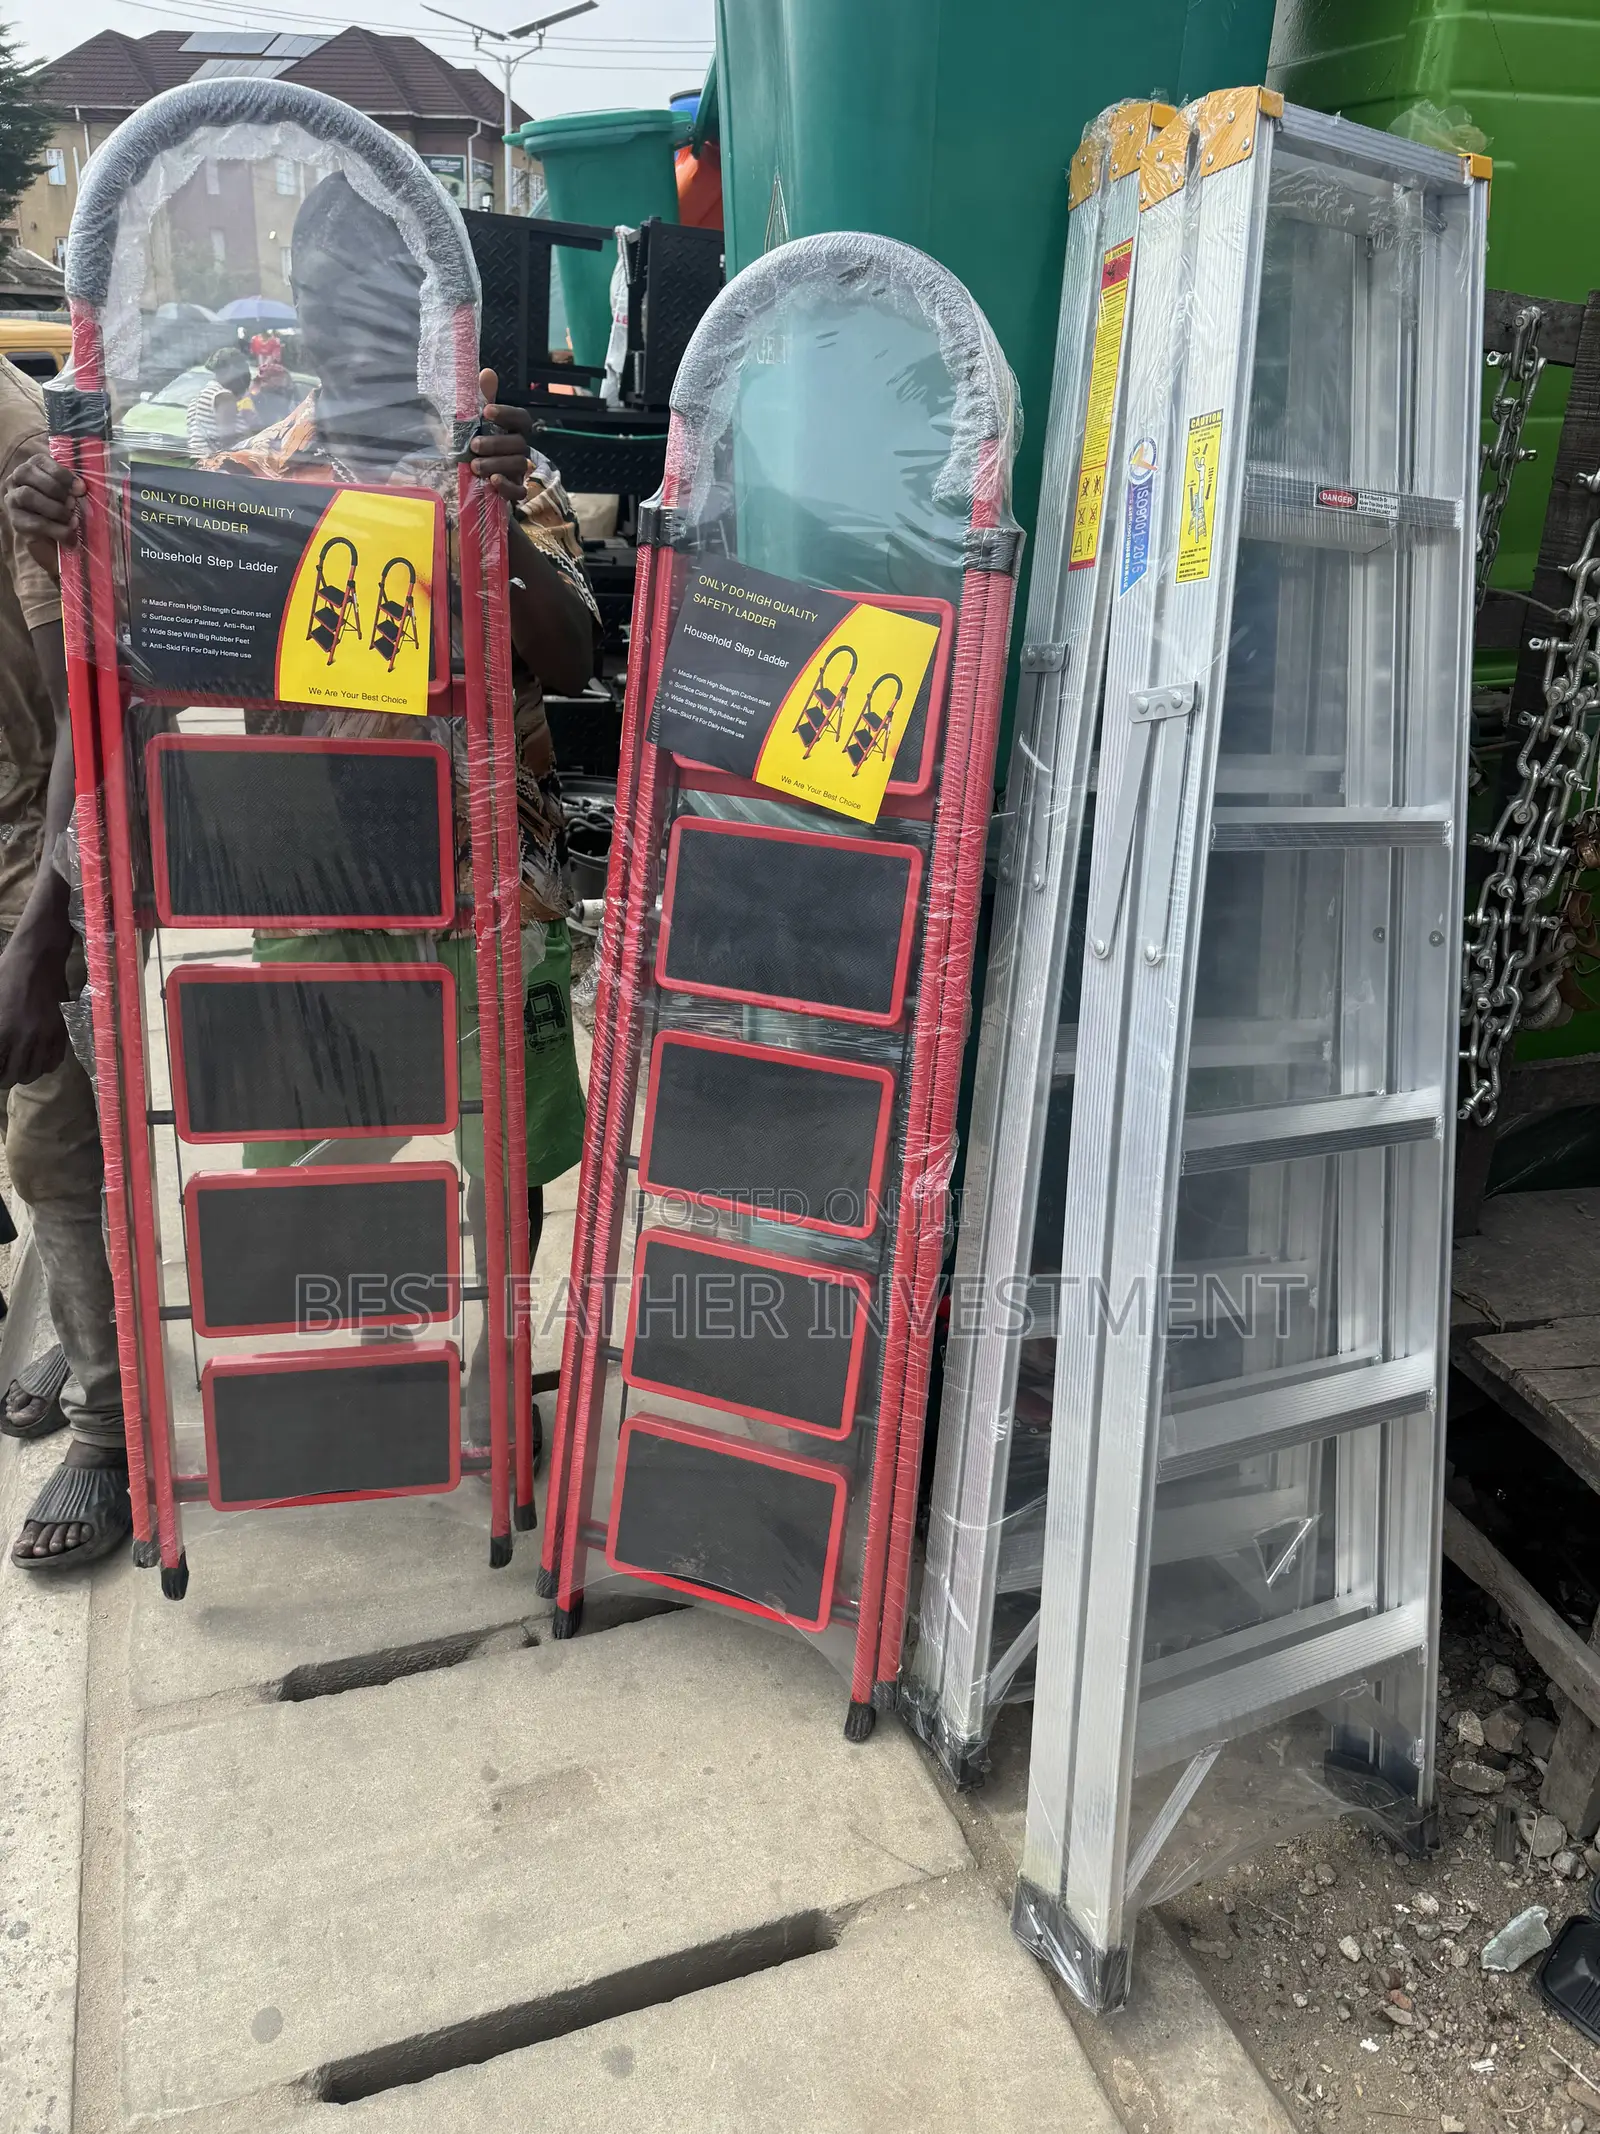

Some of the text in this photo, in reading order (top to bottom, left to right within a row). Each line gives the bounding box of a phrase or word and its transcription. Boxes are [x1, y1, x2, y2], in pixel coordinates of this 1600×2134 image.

[1191, 412, 1222, 428] CAUTION
[141, 490, 294, 519] ONLY DO HIGH QUALITY
[1322, 493, 1353, 504] DANGER
[141, 511, 248, 534] SAFETY LADDER
[141, 548, 278, 573] Household Step Ladder
[149, 599, 167, 607] Made
[169, 601, 185, 609] From
[187, 603, 201, 611] High
[202, 605, 230, 614] Strength
[699, 576, 818, 622] ONLY DO HIGH QUALITY
[693, 593, 776, 629] SAFETY LADDER
[149, 613, 174, 622] Surface
[176, 616, 193, 624] Color
[224, 622, 255, 631] Anti-Rust
[199, 633, 209, 641] Big
[684, 624, 789, 668] Household Step Ladder
[149, 643, 180, 651] Anti-Skid
[203, 648, 219, 656] Daily
[309, 687, 407, 704] We Are Your Best Choice
[674, 682, 694, 693] Surface
[695, 689, 709, 698] Color
[678, 669, 771, 707] Made From High Strength Carbon steel
[671, 694, 747, 726] Wide Step With Big Rubber Feet
[699, 717, 707, 725] For
[708, 721, 720, 730] Daily
[720, 726, 735, 735] Home
[781, 775, 861, 809] We Are Your Best Choice
